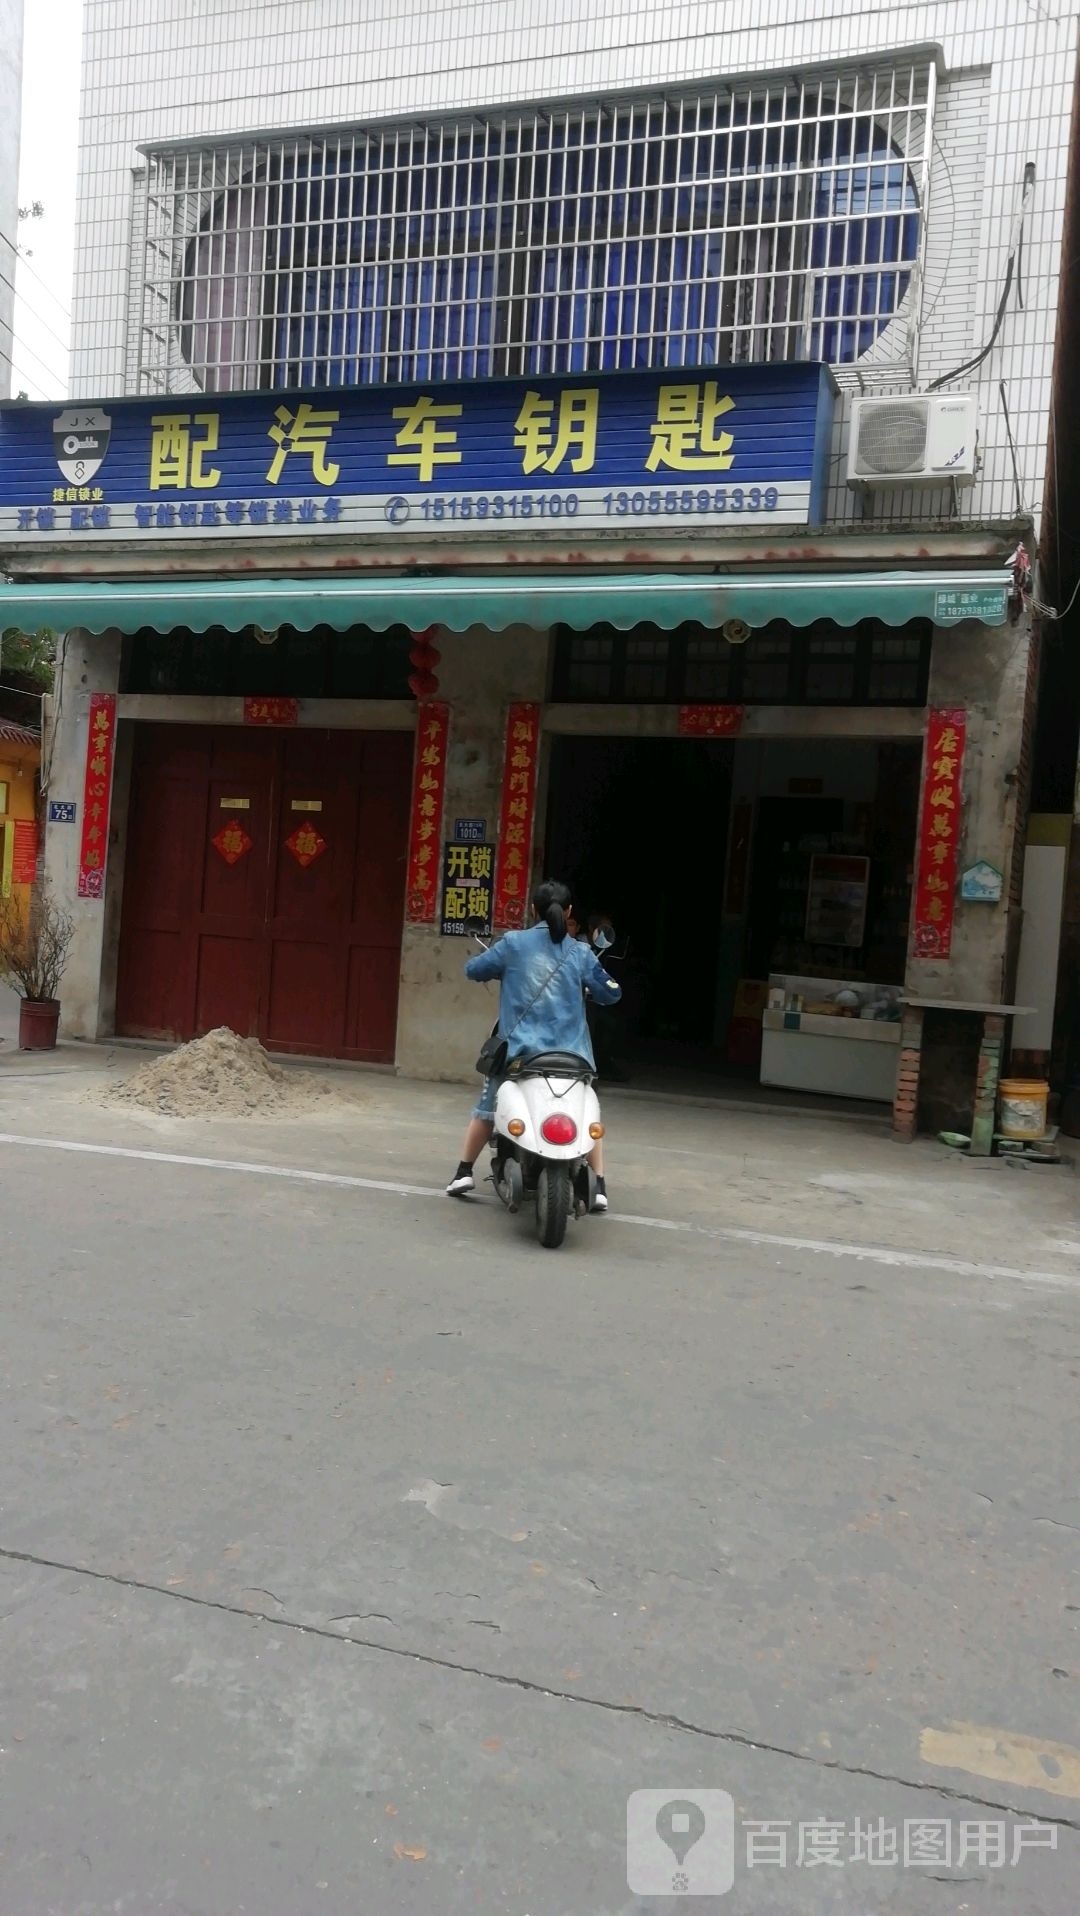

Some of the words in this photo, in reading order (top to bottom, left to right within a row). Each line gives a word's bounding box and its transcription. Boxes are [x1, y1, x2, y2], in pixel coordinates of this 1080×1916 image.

[149, 381, 736, 491] 配汽车钥匙
[17, 506, 56, 530] 开锁
[70, 504, 111, 529] 配锁
[420, 493, 579, 521] 15159315100
[602, 486, 779, 516] 13055595339
[447, 846, 491, 880] 开锁
[444, 887, 489, 920] 配锁
